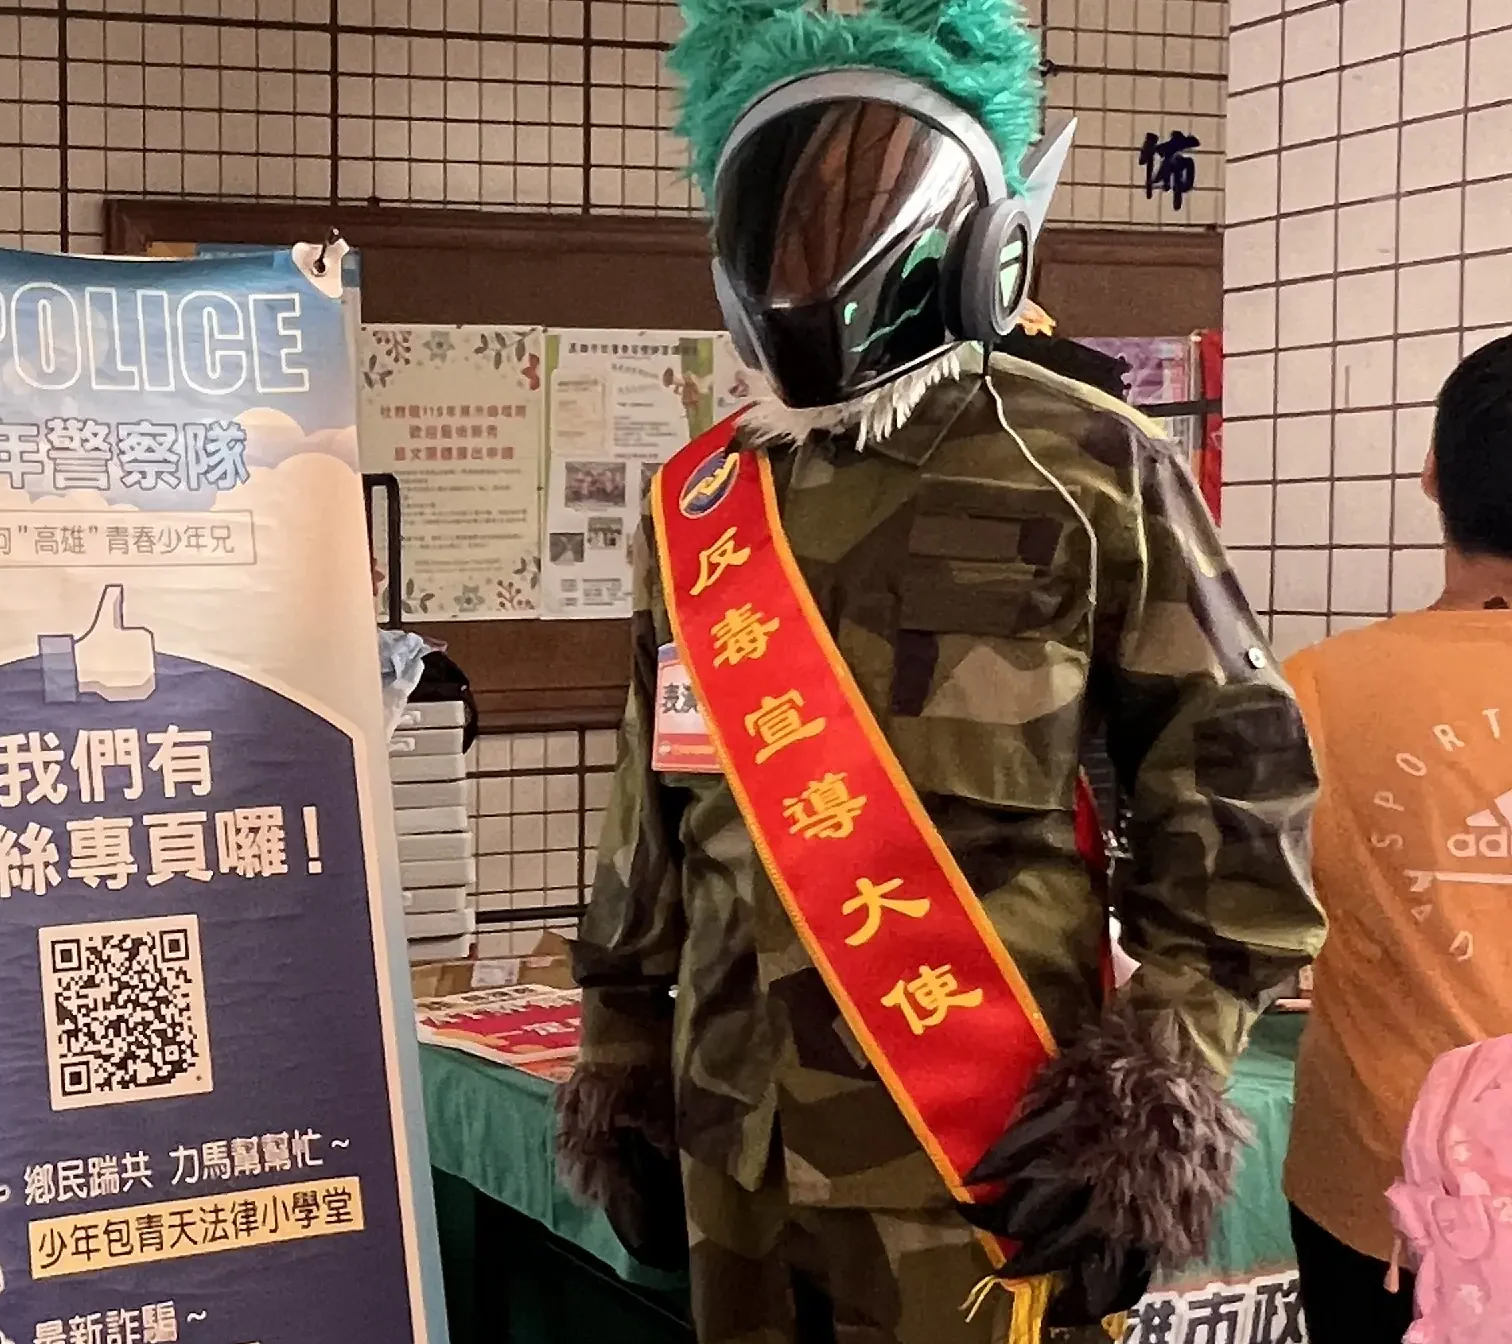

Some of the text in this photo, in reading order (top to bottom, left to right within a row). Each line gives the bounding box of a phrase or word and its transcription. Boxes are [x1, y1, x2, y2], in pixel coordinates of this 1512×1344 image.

[689, 527, 984, 1035] 反毒宣導大使
[23, 1152, 154, 1206] 鄉民踹共
[37, 1186, 354, 1270] 少年包青天法律小學堂
